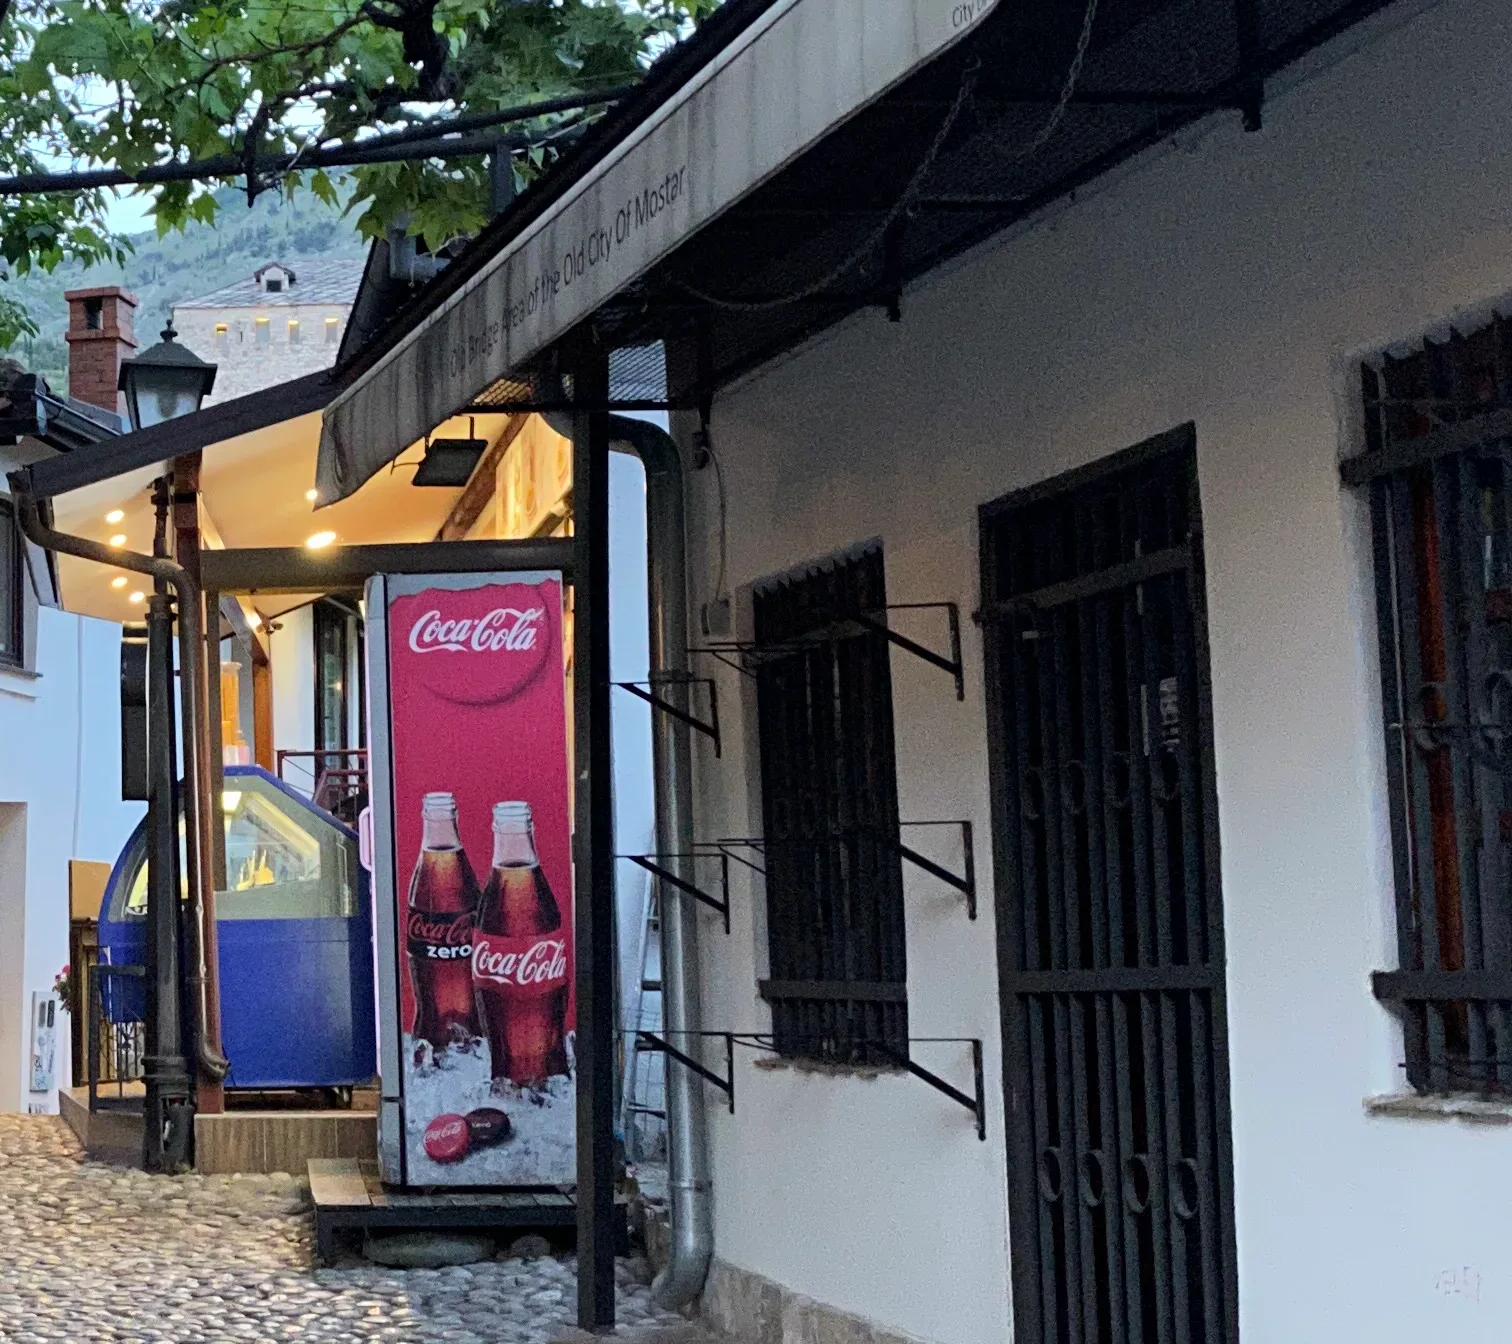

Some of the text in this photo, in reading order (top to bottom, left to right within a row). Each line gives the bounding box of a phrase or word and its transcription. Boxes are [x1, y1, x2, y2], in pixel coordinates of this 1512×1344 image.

[952, 0, 975, 28] City
[528, 276, 540, 316] of
[541, 269, 561, 305] the
[563, 239, 585, 286] Old
[588, 225, 613, 266] City
[615, 199, 632, 244] Of
[634, 164, 686, 230] Mostar
[408, 607, 545, 654] Coca-Cola
[426, 944, 473, 959] zero
[471, 938, 567, 986] Coca-Cola
